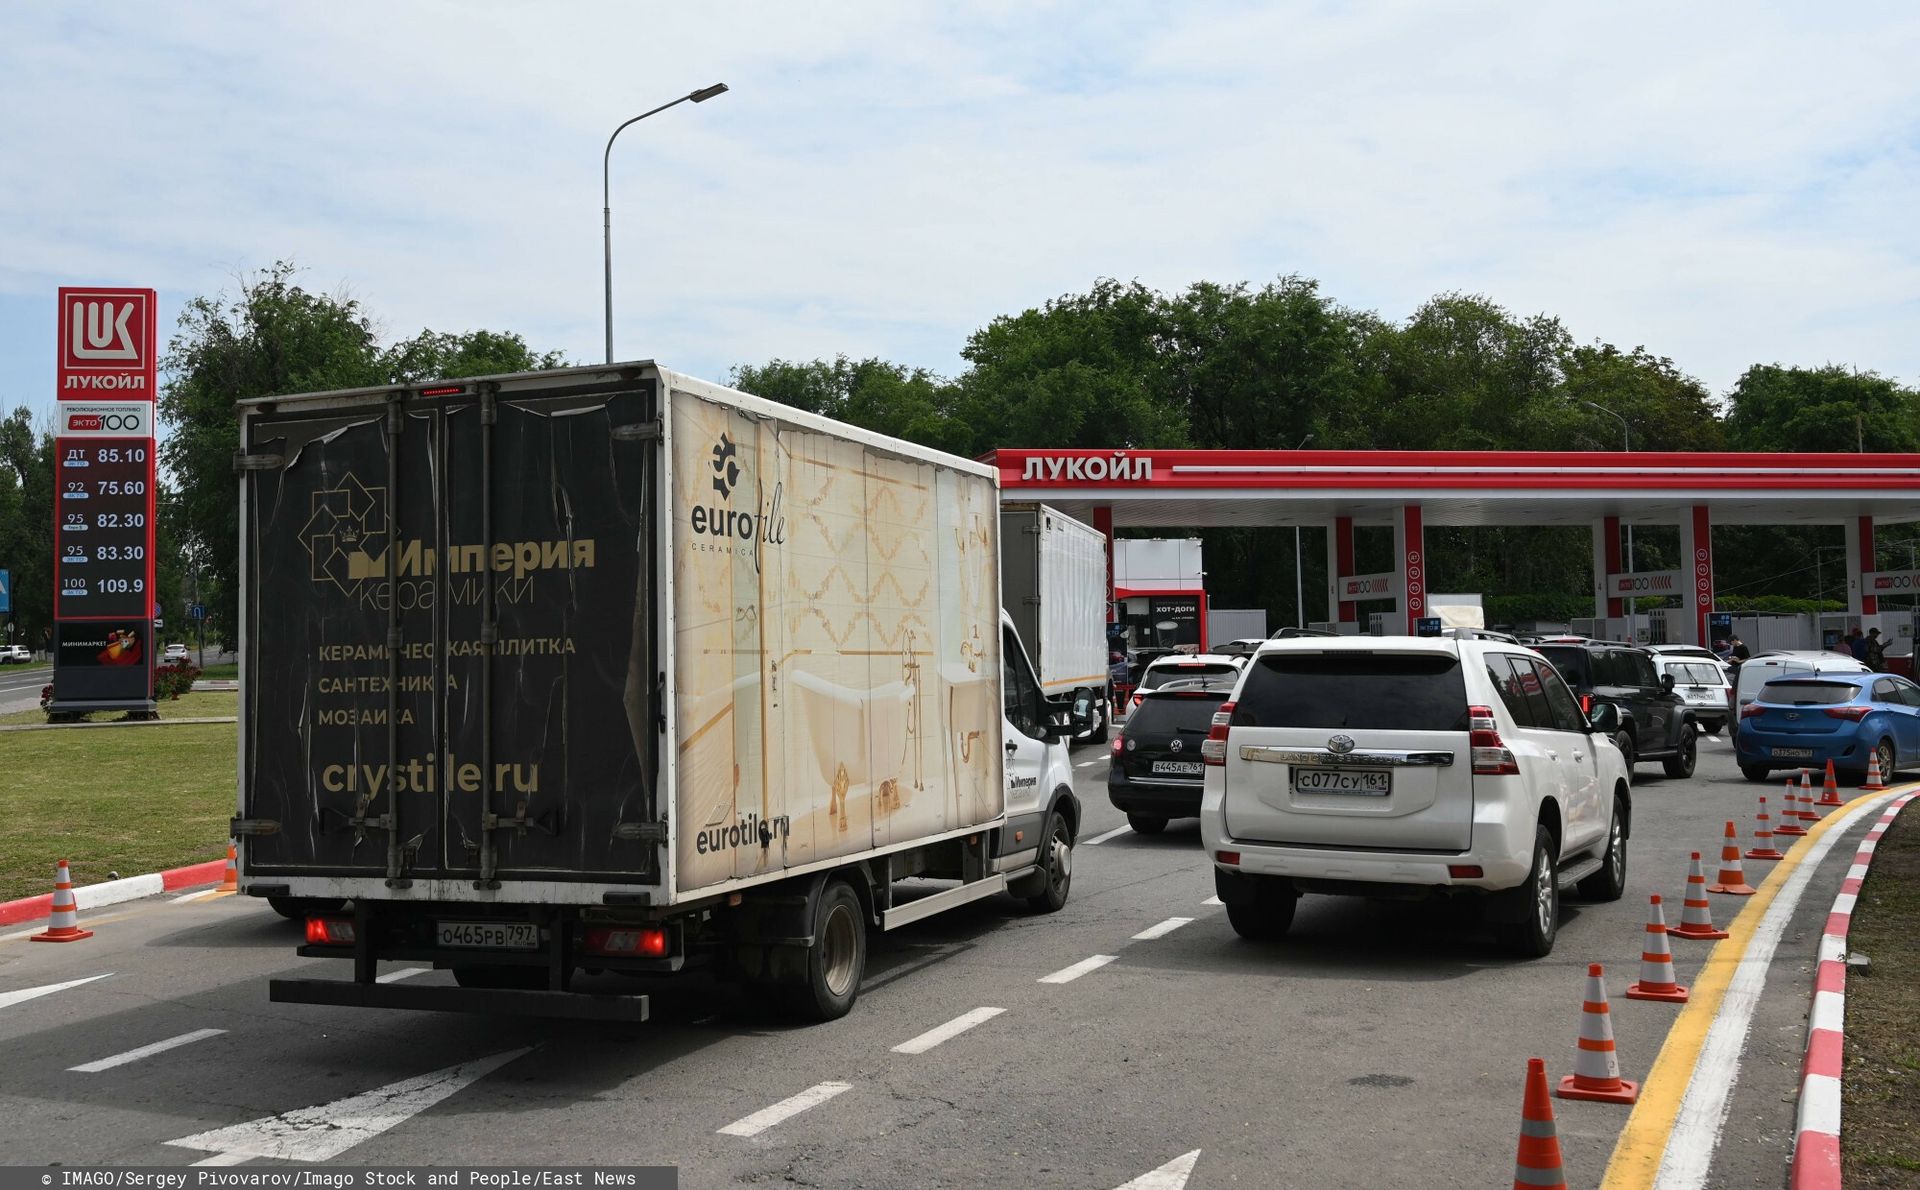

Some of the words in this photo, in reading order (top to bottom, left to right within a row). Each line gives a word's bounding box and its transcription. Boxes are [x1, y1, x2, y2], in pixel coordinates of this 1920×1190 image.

[64, 372, 145, 390] ЛУКОЙЛ
[72, 419, 97, 427] ЭКТО
[99, 414, 140, 431] 100
[67, 449, 85, 460] ДТ
[98, 448, 145, 463] 85.10
[1021, 451, 1153, 481] ЛУКОЙЛ
[68, 481, 84, 492] 92
[98, 481, 145, 495] 75.60
[67, 513, 84, 524] 95
[97, 513, 144, 528] 82.30
[67, 545, 84, 556] 95
[97, 546, 144, 560] 83.30
[396, 539, 595, 579] Империя
[64, 578, 86, 588] 100
[97, 579, 144, 593] 109.9
[62, 640, 107, 648] МИНИМАРКЕТ
[318, 709, 415, 725] МОЗАИА
[1363, 773, 1385, 786] 161
[507, 925, 533, 941] 797
